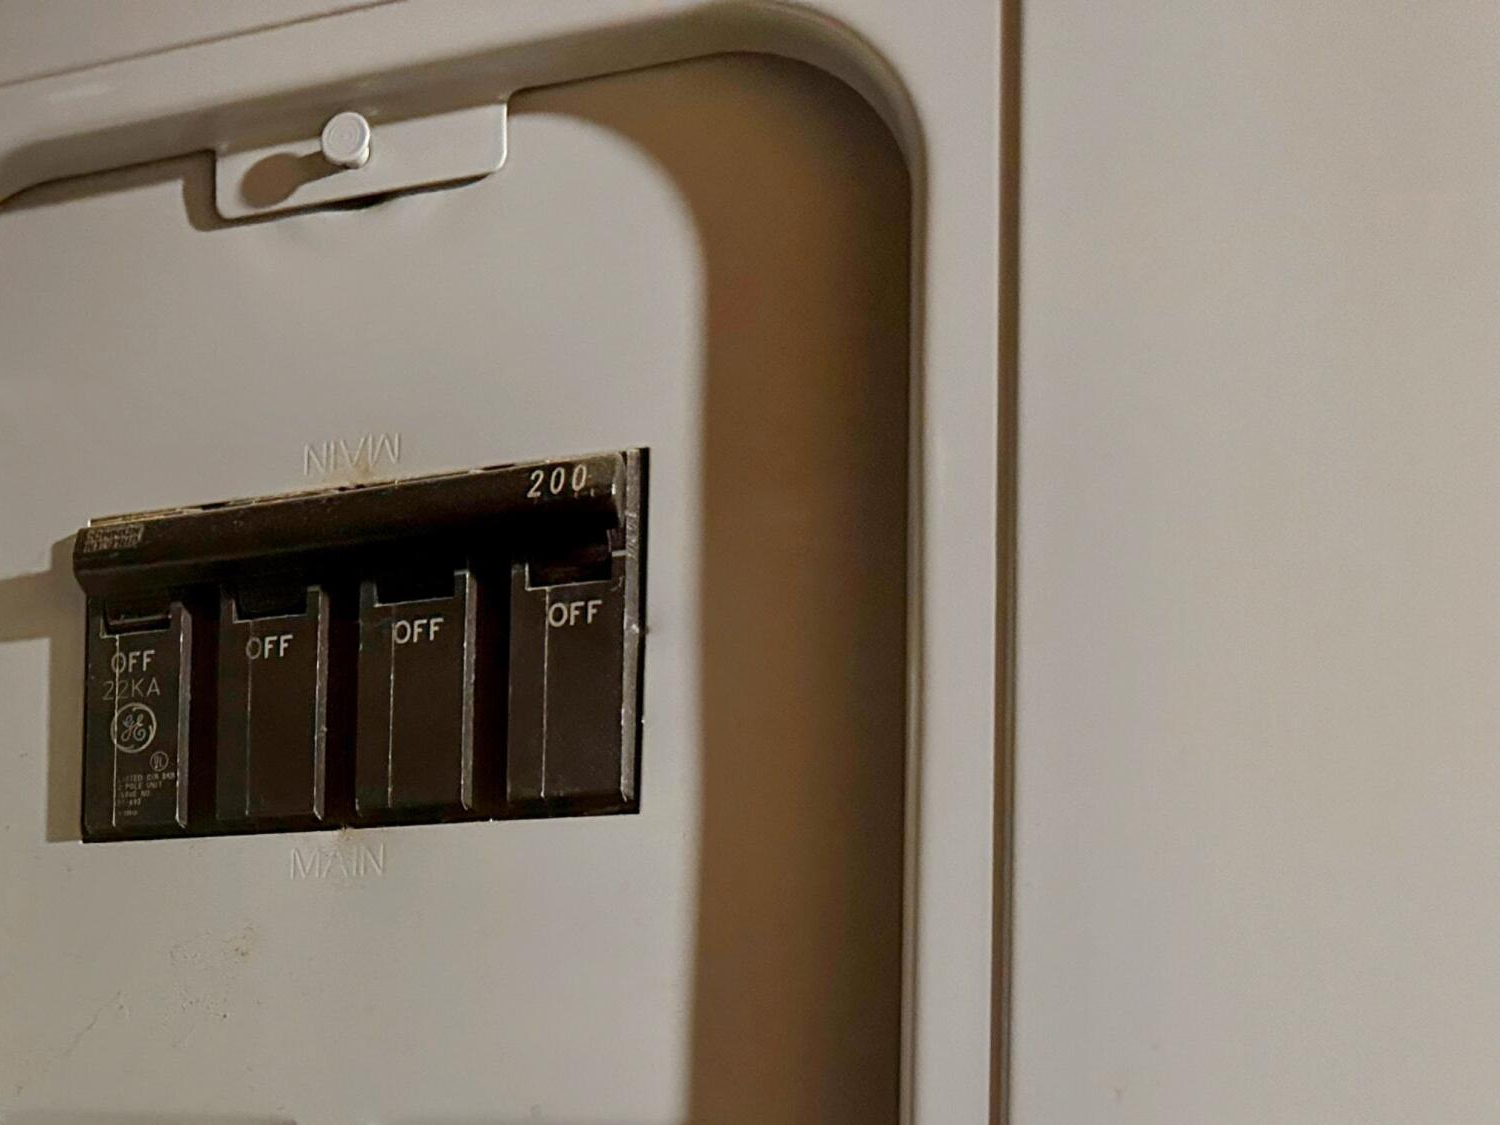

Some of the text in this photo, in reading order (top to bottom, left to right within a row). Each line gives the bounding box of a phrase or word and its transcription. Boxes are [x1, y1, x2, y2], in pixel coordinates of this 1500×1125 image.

[527, 464, 587, 497] 200
[548, 600, 602, 628] OFF
[394, 618, 443, 644] OFF
[246, 635, 293, 659] OFF
[111, 650, 155, 673] OFF
